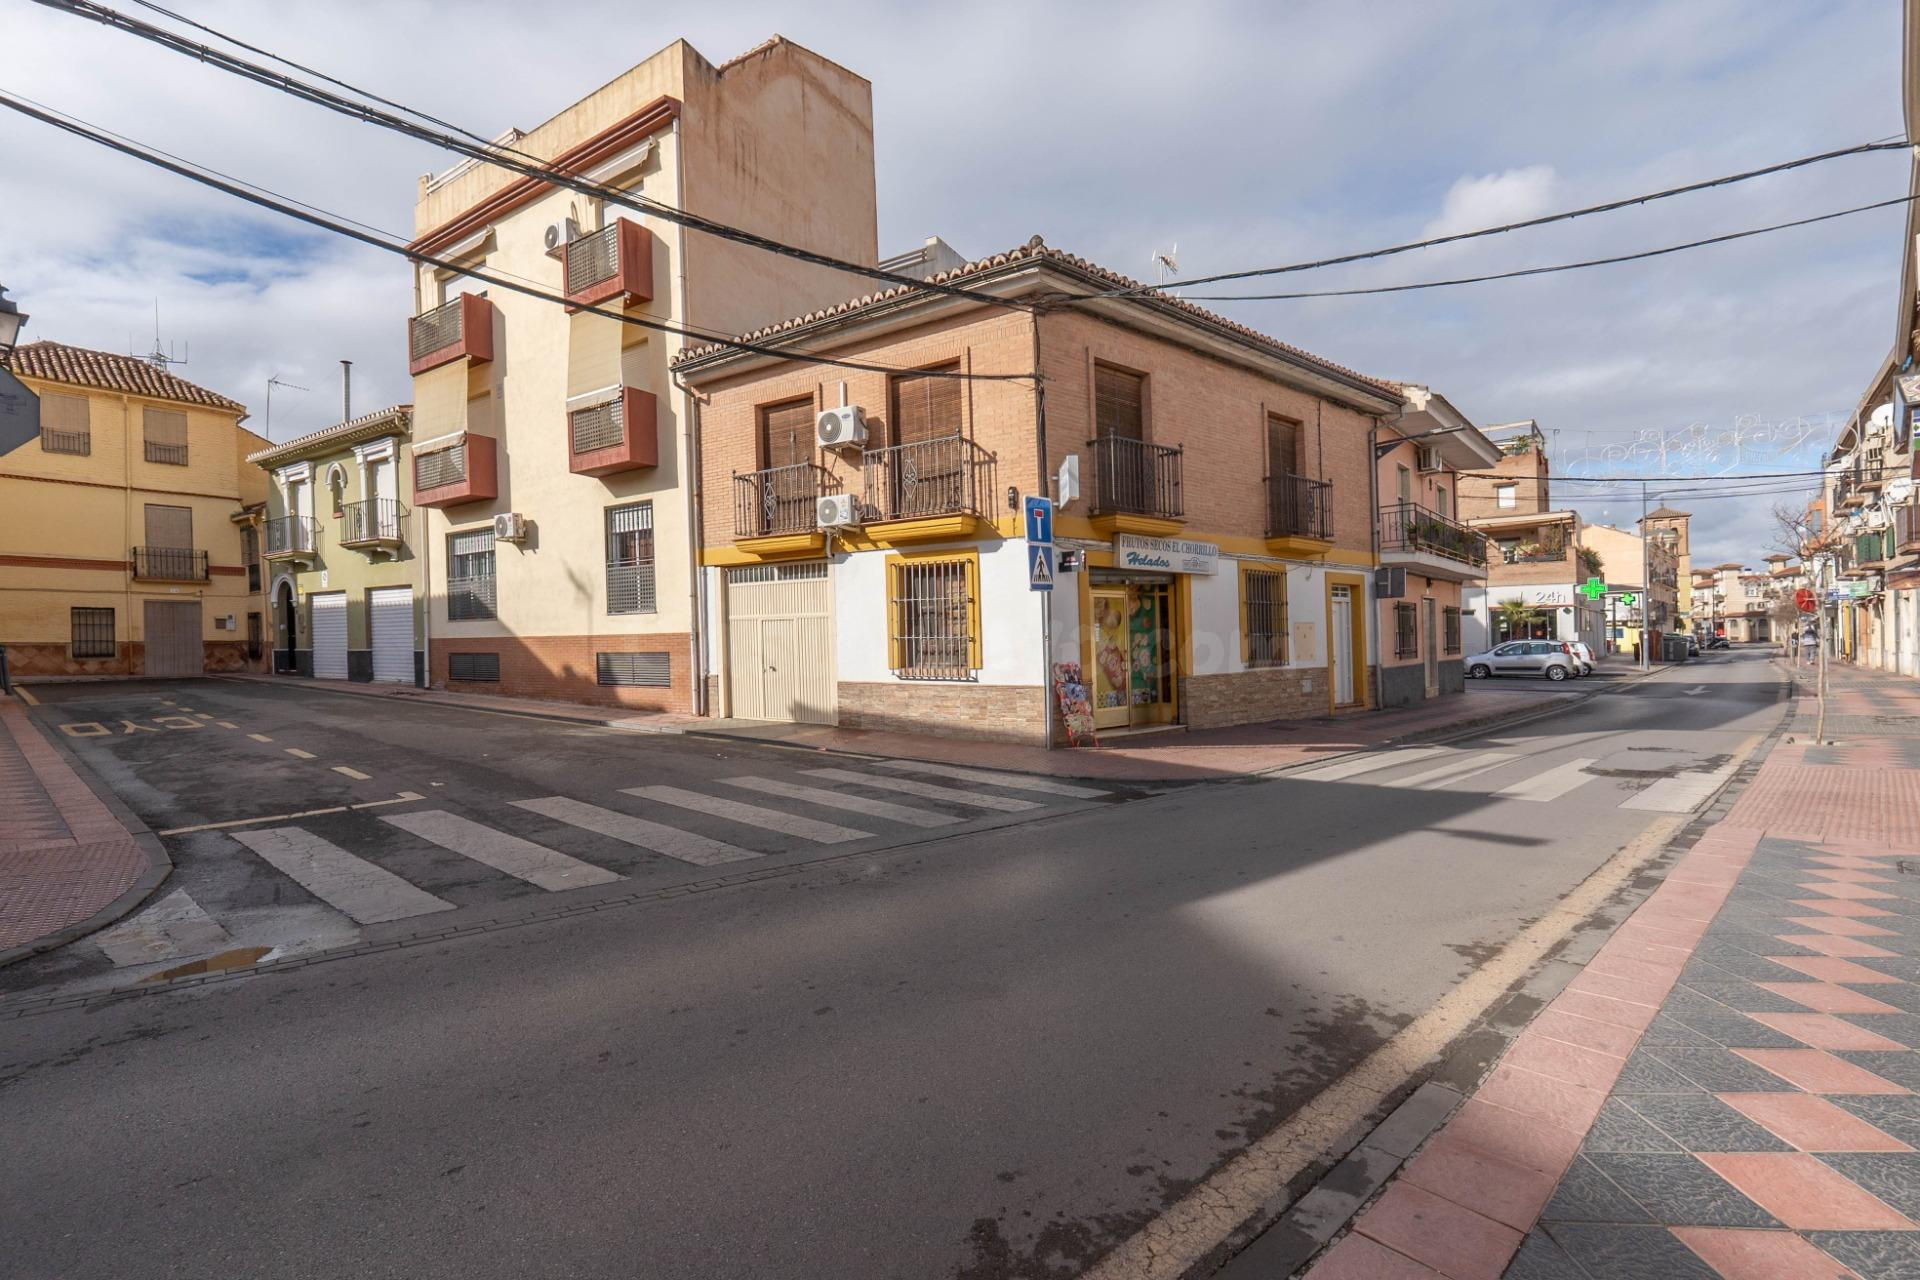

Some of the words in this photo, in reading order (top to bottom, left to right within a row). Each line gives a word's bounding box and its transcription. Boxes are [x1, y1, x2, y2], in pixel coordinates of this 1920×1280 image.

[1121, 535, 1149, 550] FRUTOS
[1150, 538, 1171, 552] SECOS
[1172, 541, 1180, 553] EL
[1181, 542, 1217, 557] CHORRILLO
[1126, 551, 1170, 568] Helados
[1535, 591, 1567, 604] 24h
